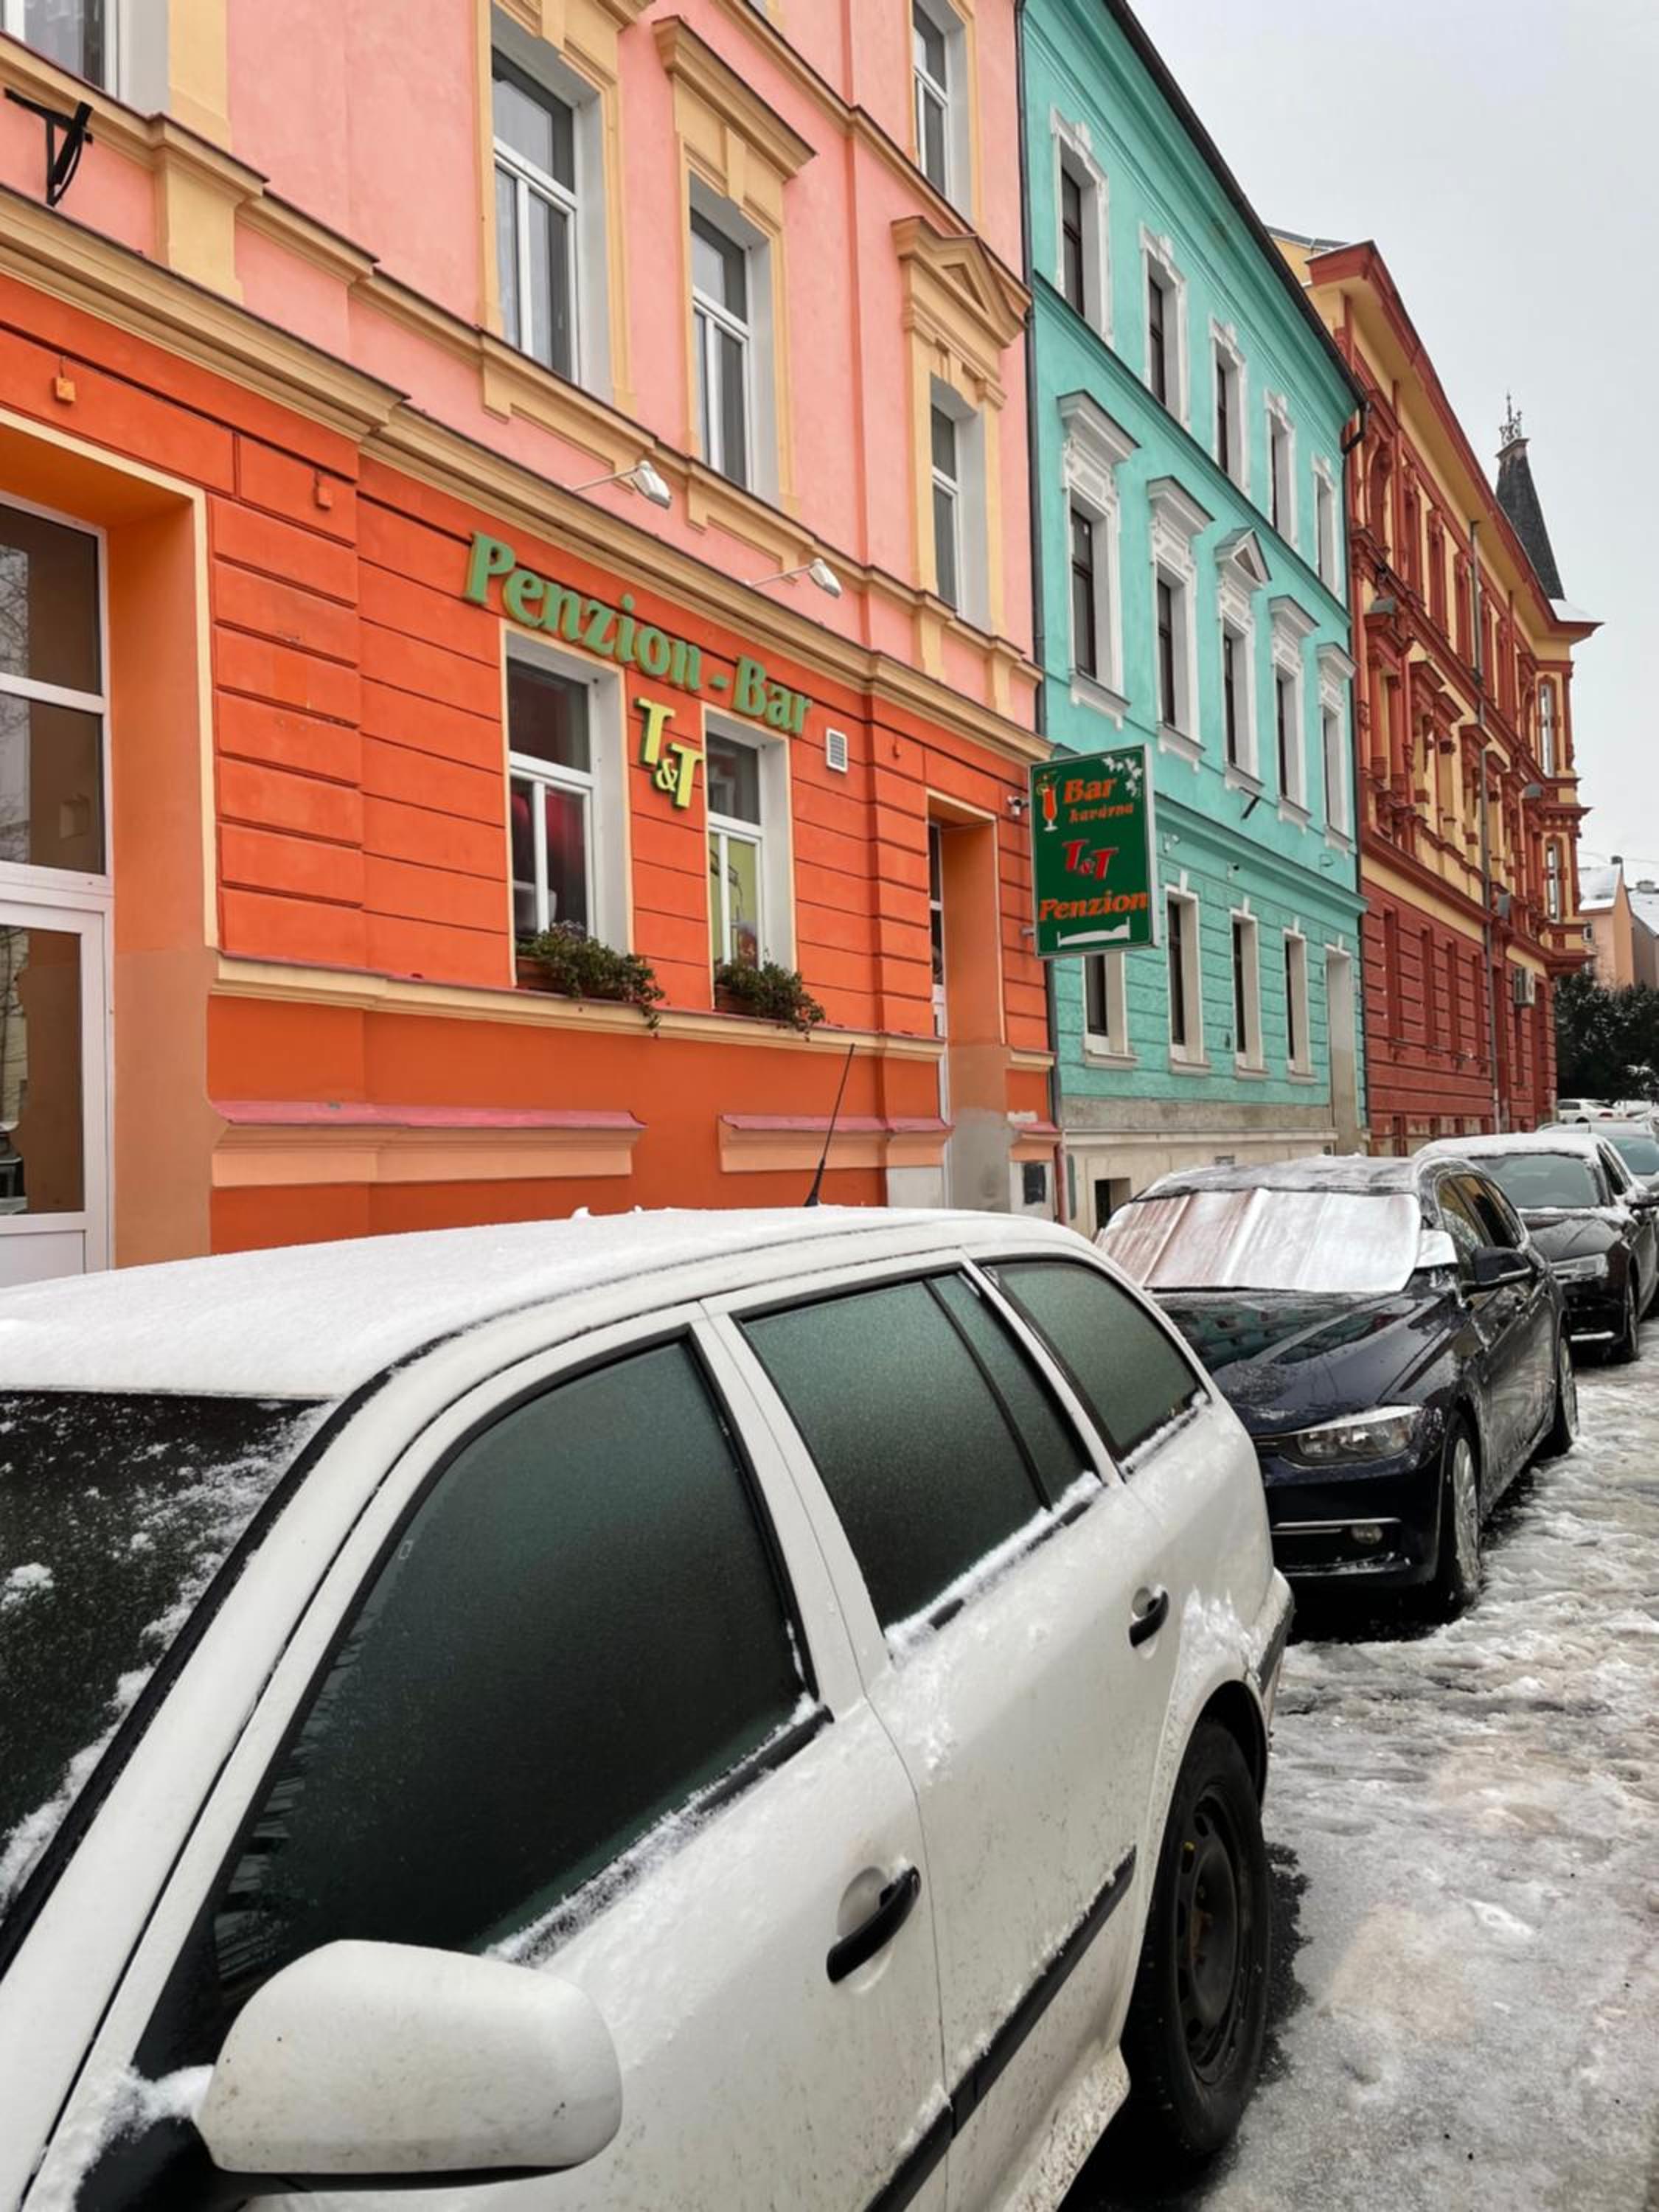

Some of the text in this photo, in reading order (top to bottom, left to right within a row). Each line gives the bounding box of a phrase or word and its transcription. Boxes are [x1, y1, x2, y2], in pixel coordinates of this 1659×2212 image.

[633, 697, 706, 808] T&T
[1062, 778, 1117, 804] Bar
[1061, 838, 1119, 881] T&T
[1038, 889, 1149, 922] Penzion
